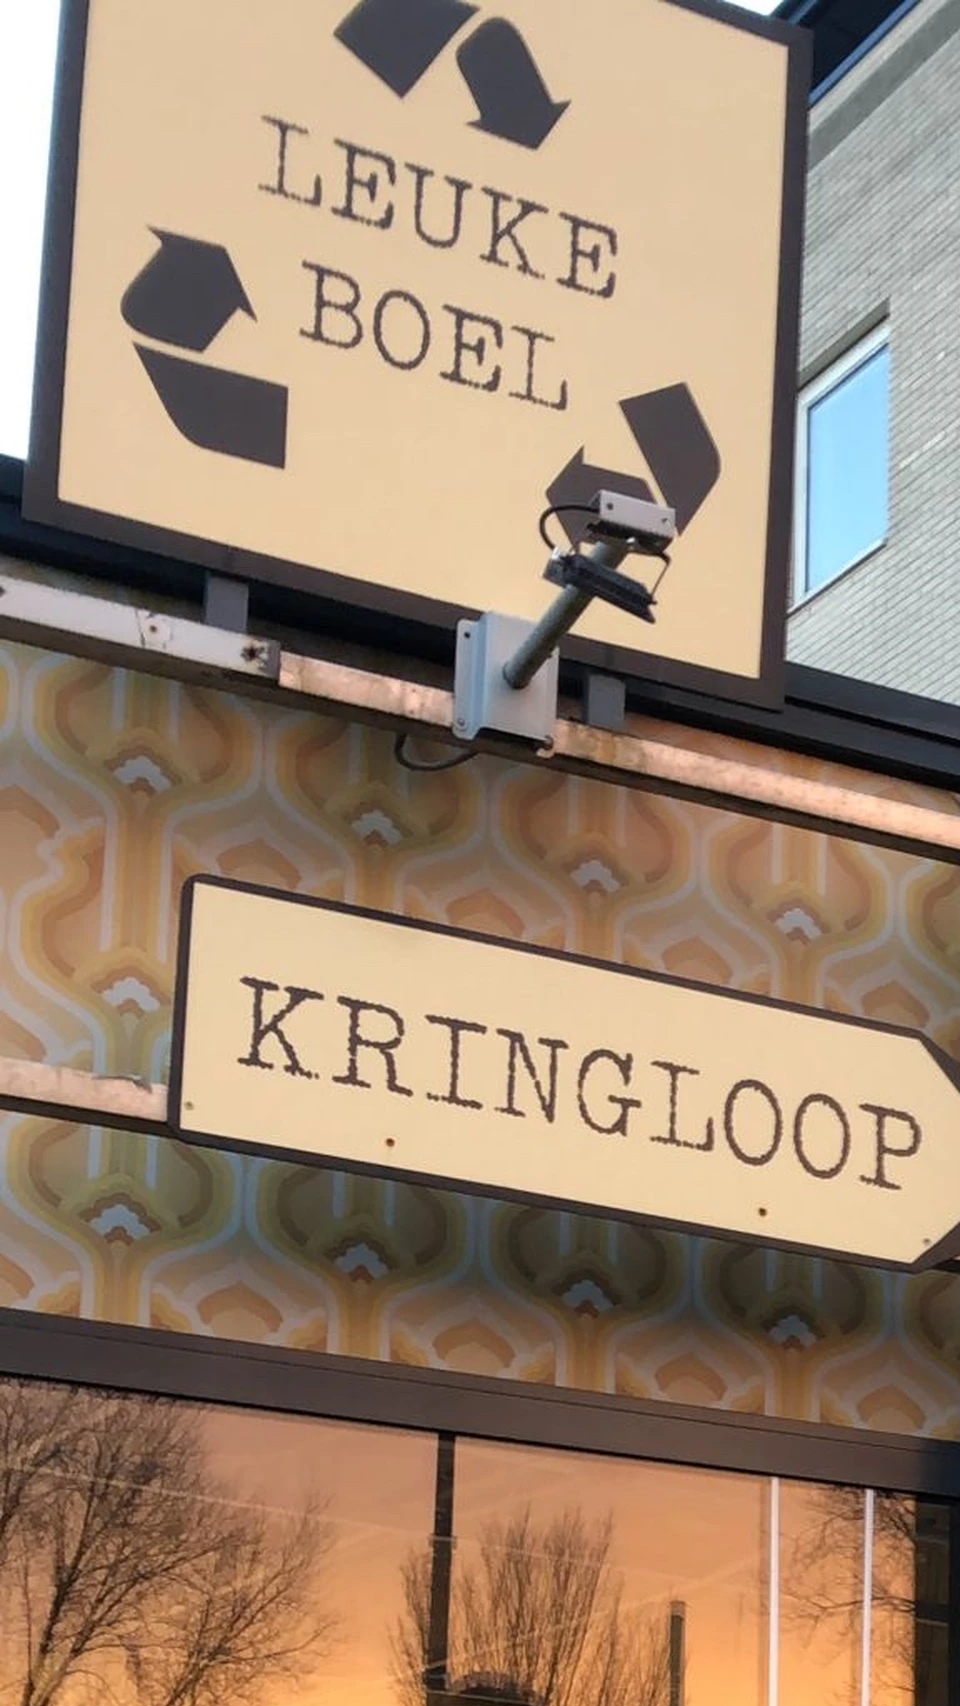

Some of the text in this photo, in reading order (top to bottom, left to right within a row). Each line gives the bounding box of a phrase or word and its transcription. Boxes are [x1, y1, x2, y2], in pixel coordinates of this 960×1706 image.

[258, 114, 620, 299] LEUKE
[298, 259, 568, 411] BOEL
[236, 976, 924, 1190] KRINGLOOP
